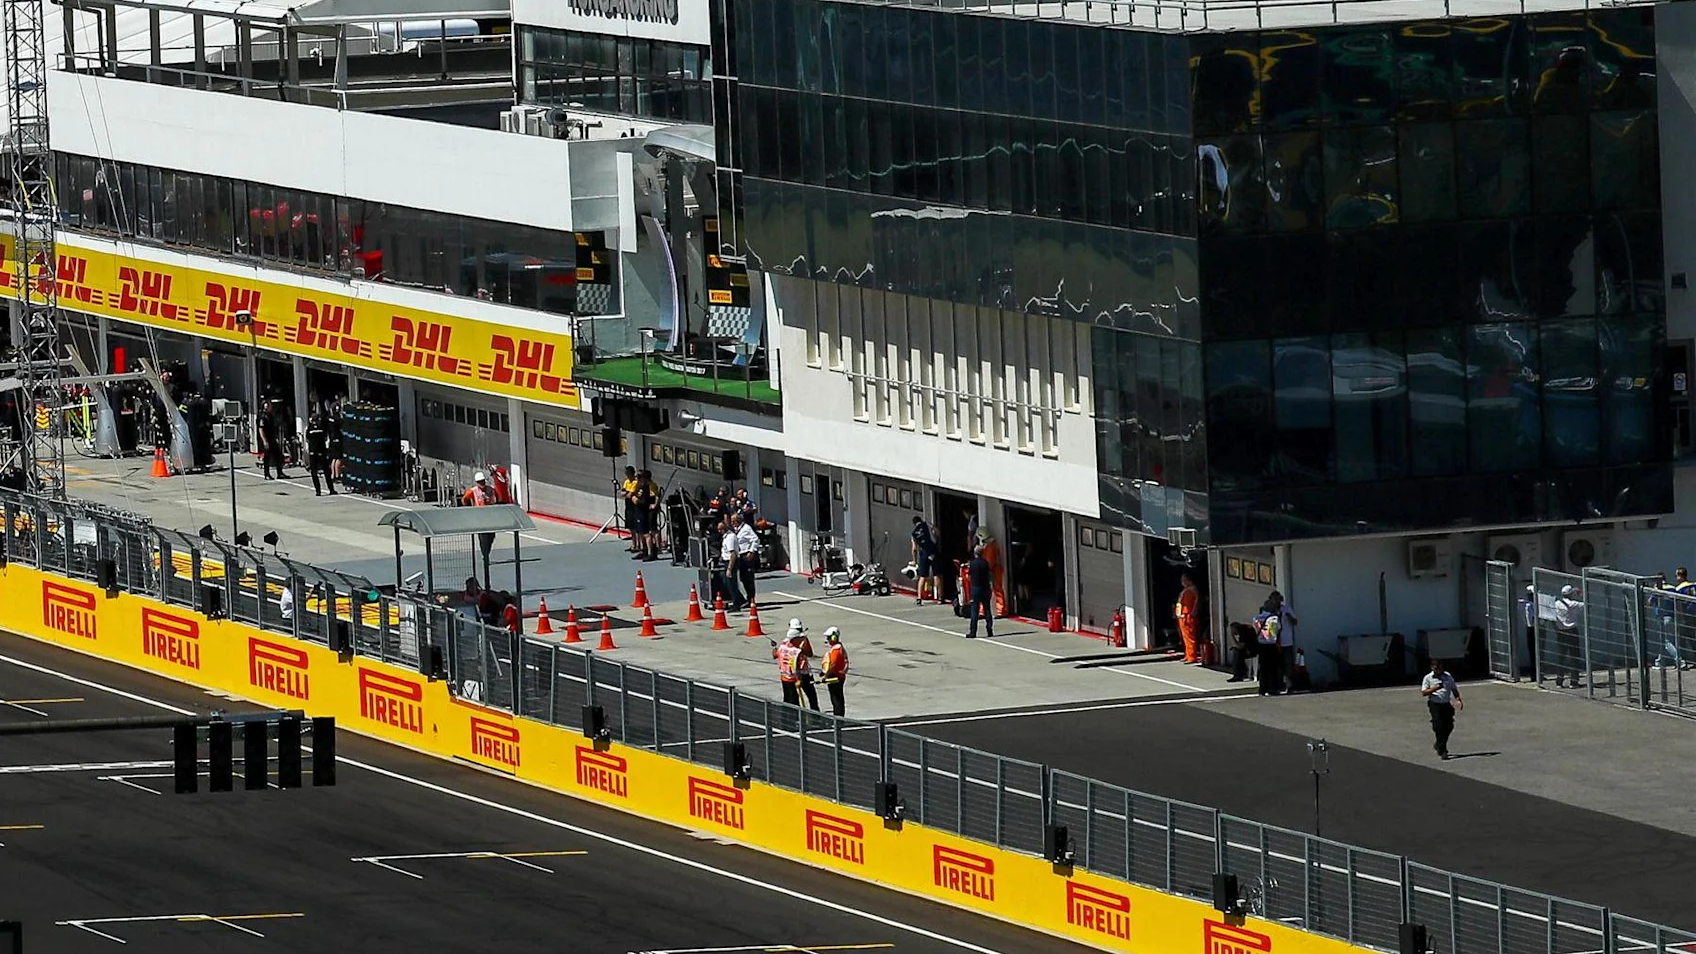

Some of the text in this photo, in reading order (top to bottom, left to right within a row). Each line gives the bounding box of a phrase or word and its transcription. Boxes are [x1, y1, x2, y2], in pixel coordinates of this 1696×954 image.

[118, 266, 175, 320] DHL
[206, 282, 266, 337] DHL
[296, 298, 361, 356] DHL
[392, 316, 458, 373] DHL
[491, 334, 560, 393] DHL
[43, 578, 96, 640] PIRELLI
[143, 608, 200, 670] PIRELLI
[250, 636, 309, 700] PIRELLI
[360, 666, 423, 734] PIRELLI
[472, 716, 520, 767] PIRELLI
[576, 746, 628, 797] PIRELLI
[689, 777, 744, 830] PIRELLI
[806, 809, 864, 865] PIRELLI
[934, 844, 994, 902] PIRELLI
[1066, 880, 1130, 940] PIRELLI
